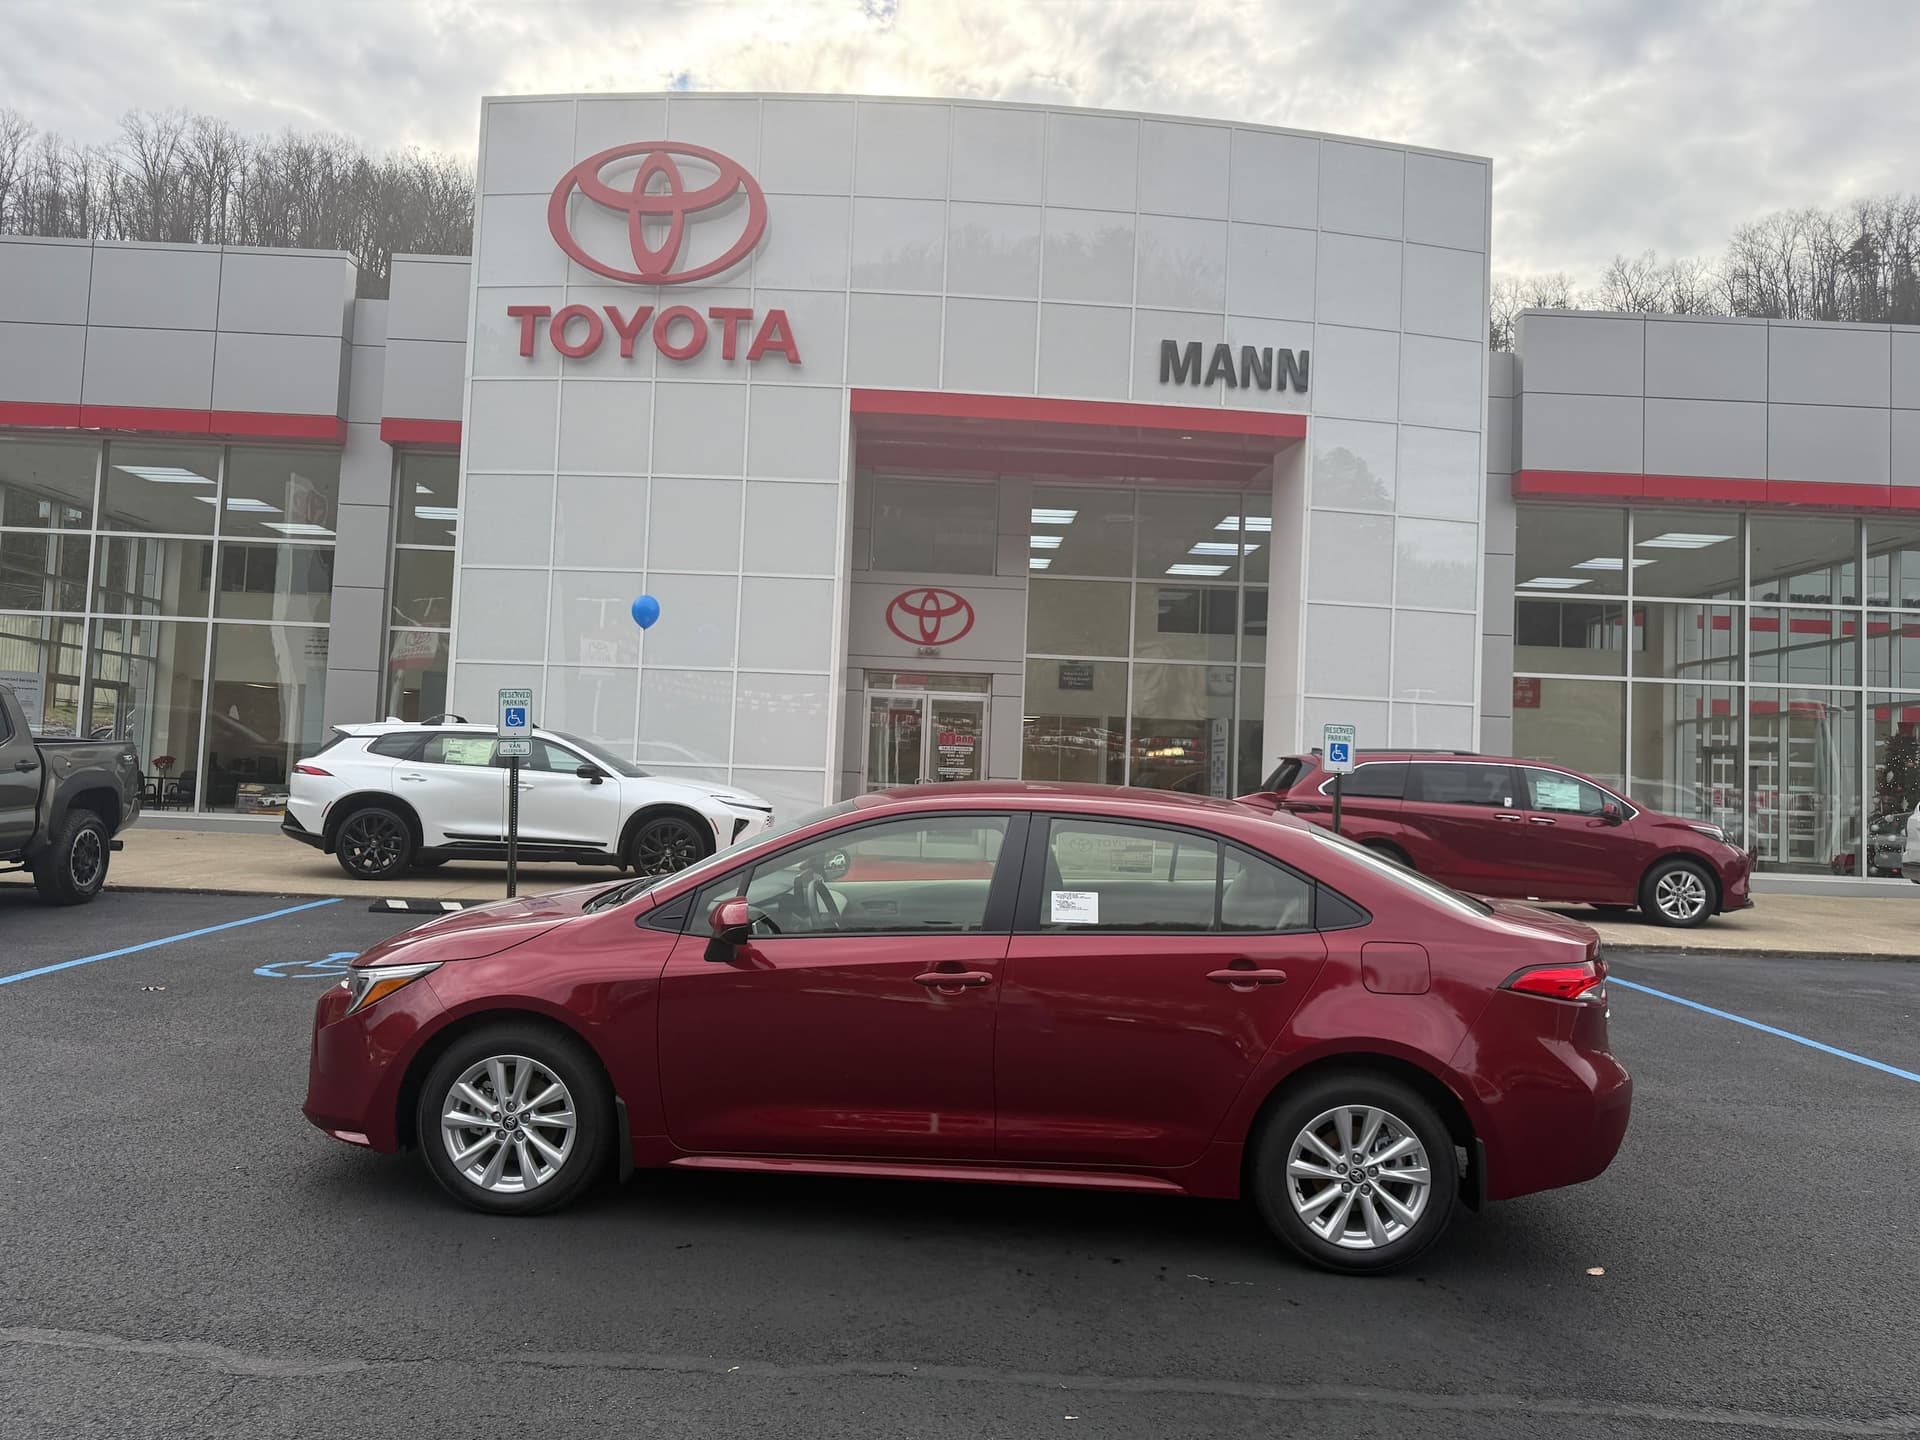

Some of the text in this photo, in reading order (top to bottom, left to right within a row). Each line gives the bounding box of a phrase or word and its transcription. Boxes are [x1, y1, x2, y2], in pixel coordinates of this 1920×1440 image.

[507, 304, 801, 364] TOYOTA
[1160, 339, 1310, 393] MANN
[500, 691, 530, 699] RESERVED
